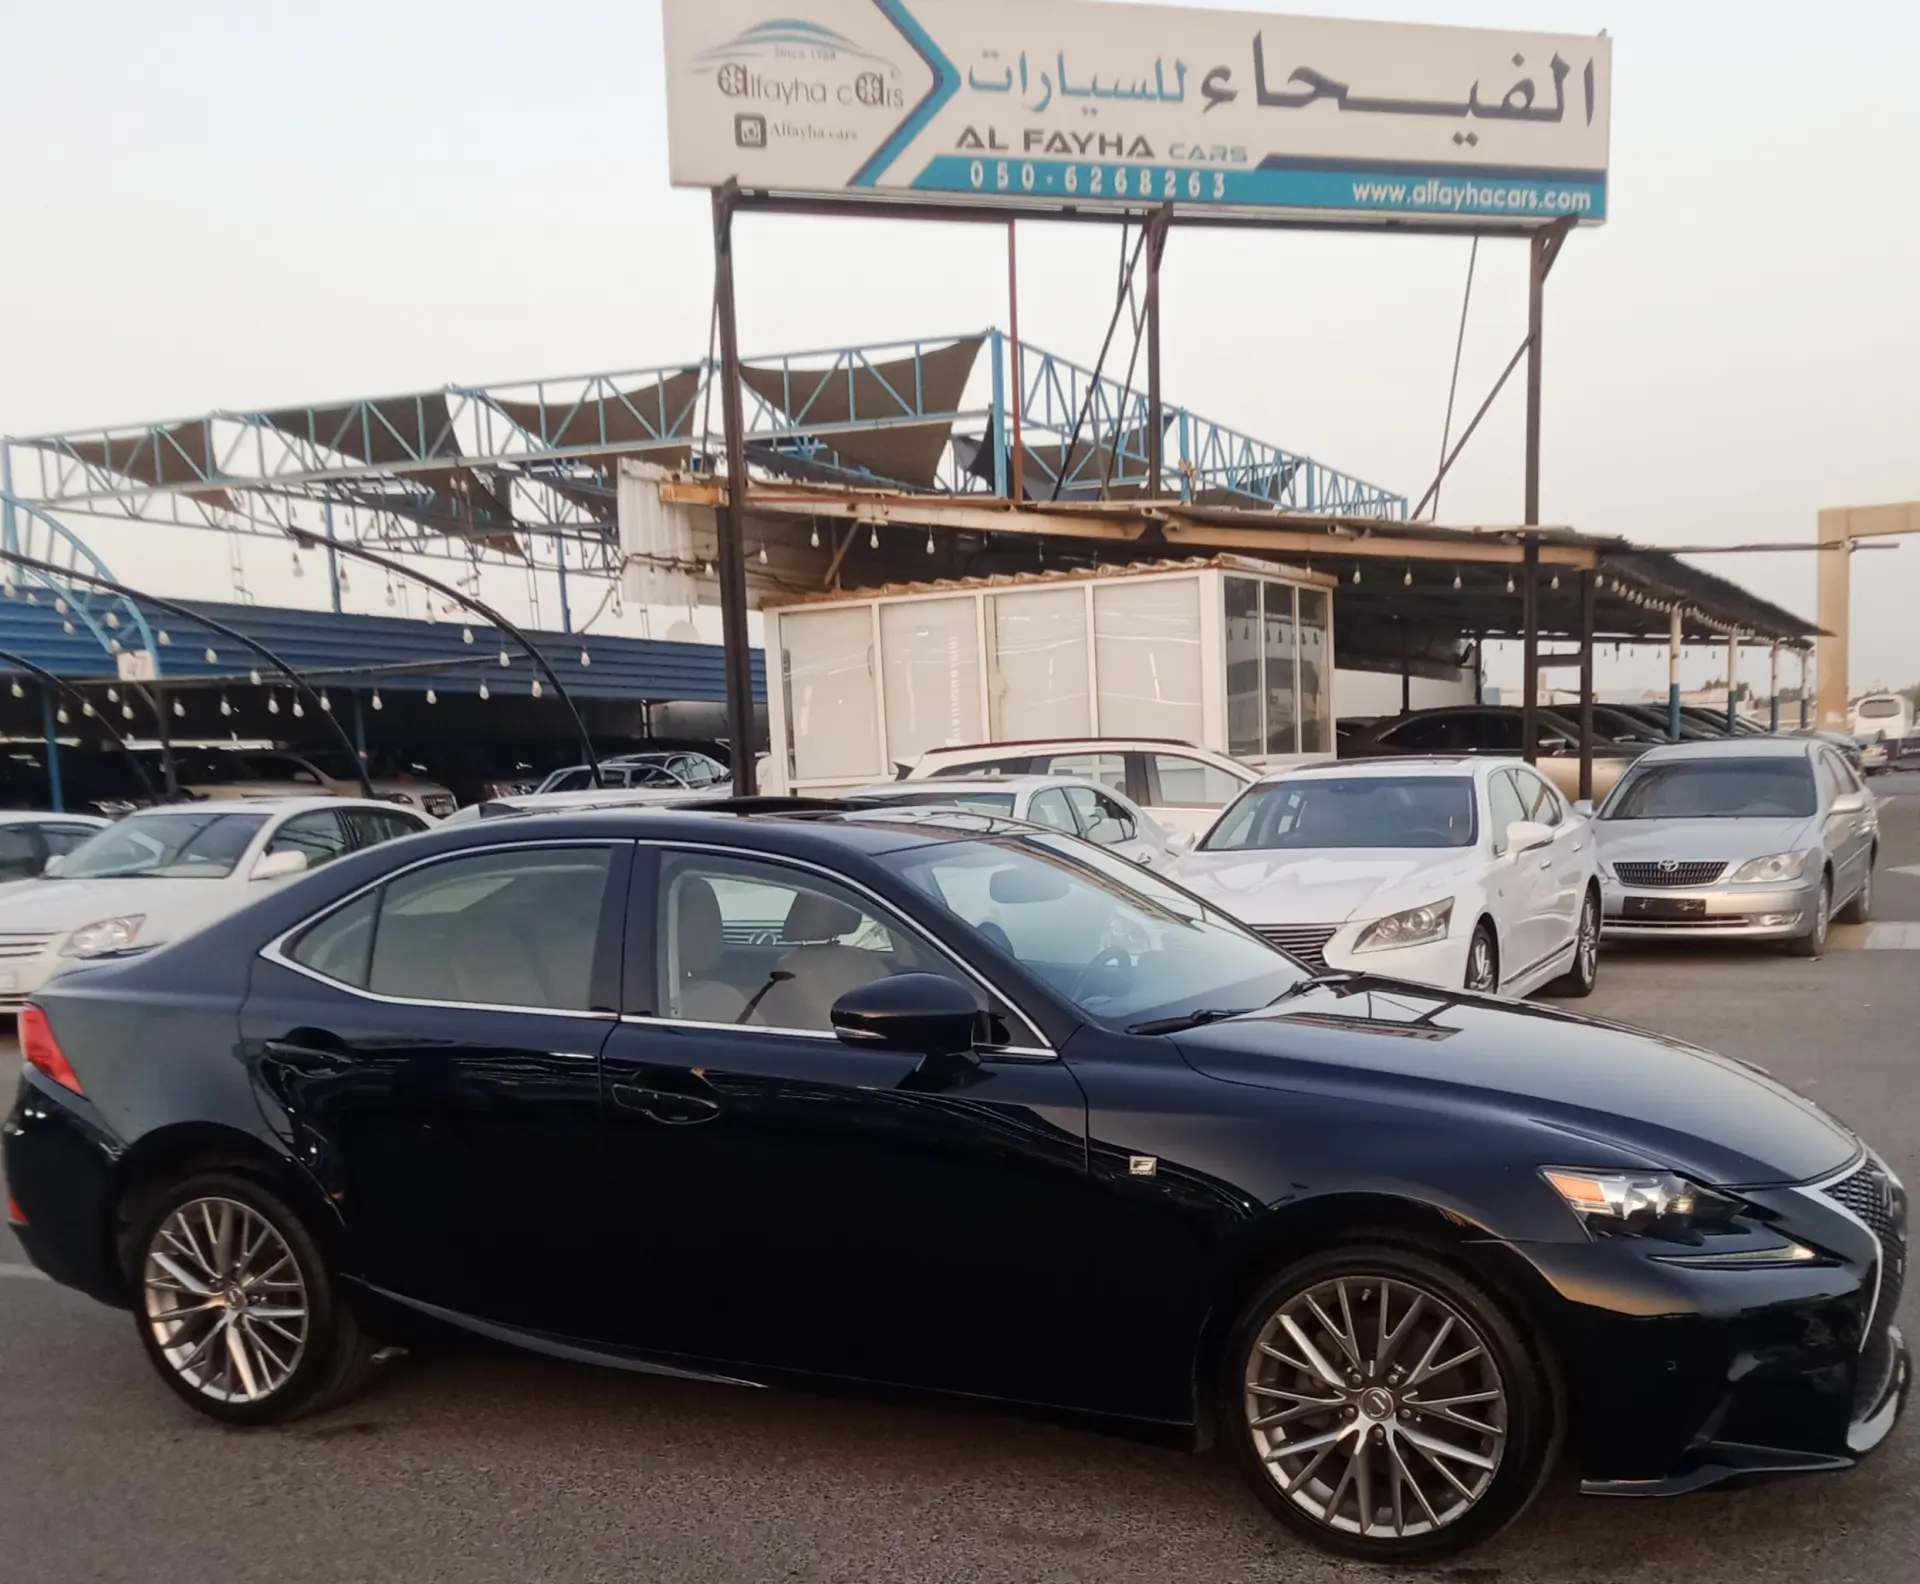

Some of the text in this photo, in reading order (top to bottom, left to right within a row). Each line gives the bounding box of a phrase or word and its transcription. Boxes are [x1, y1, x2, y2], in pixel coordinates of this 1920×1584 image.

[968, 49, 1187, 116] للسيارات
[956, 125, 1248, 163] AL FAYHA CARS
[1353, 179, 1592, 211] www.alfayhacars.com
